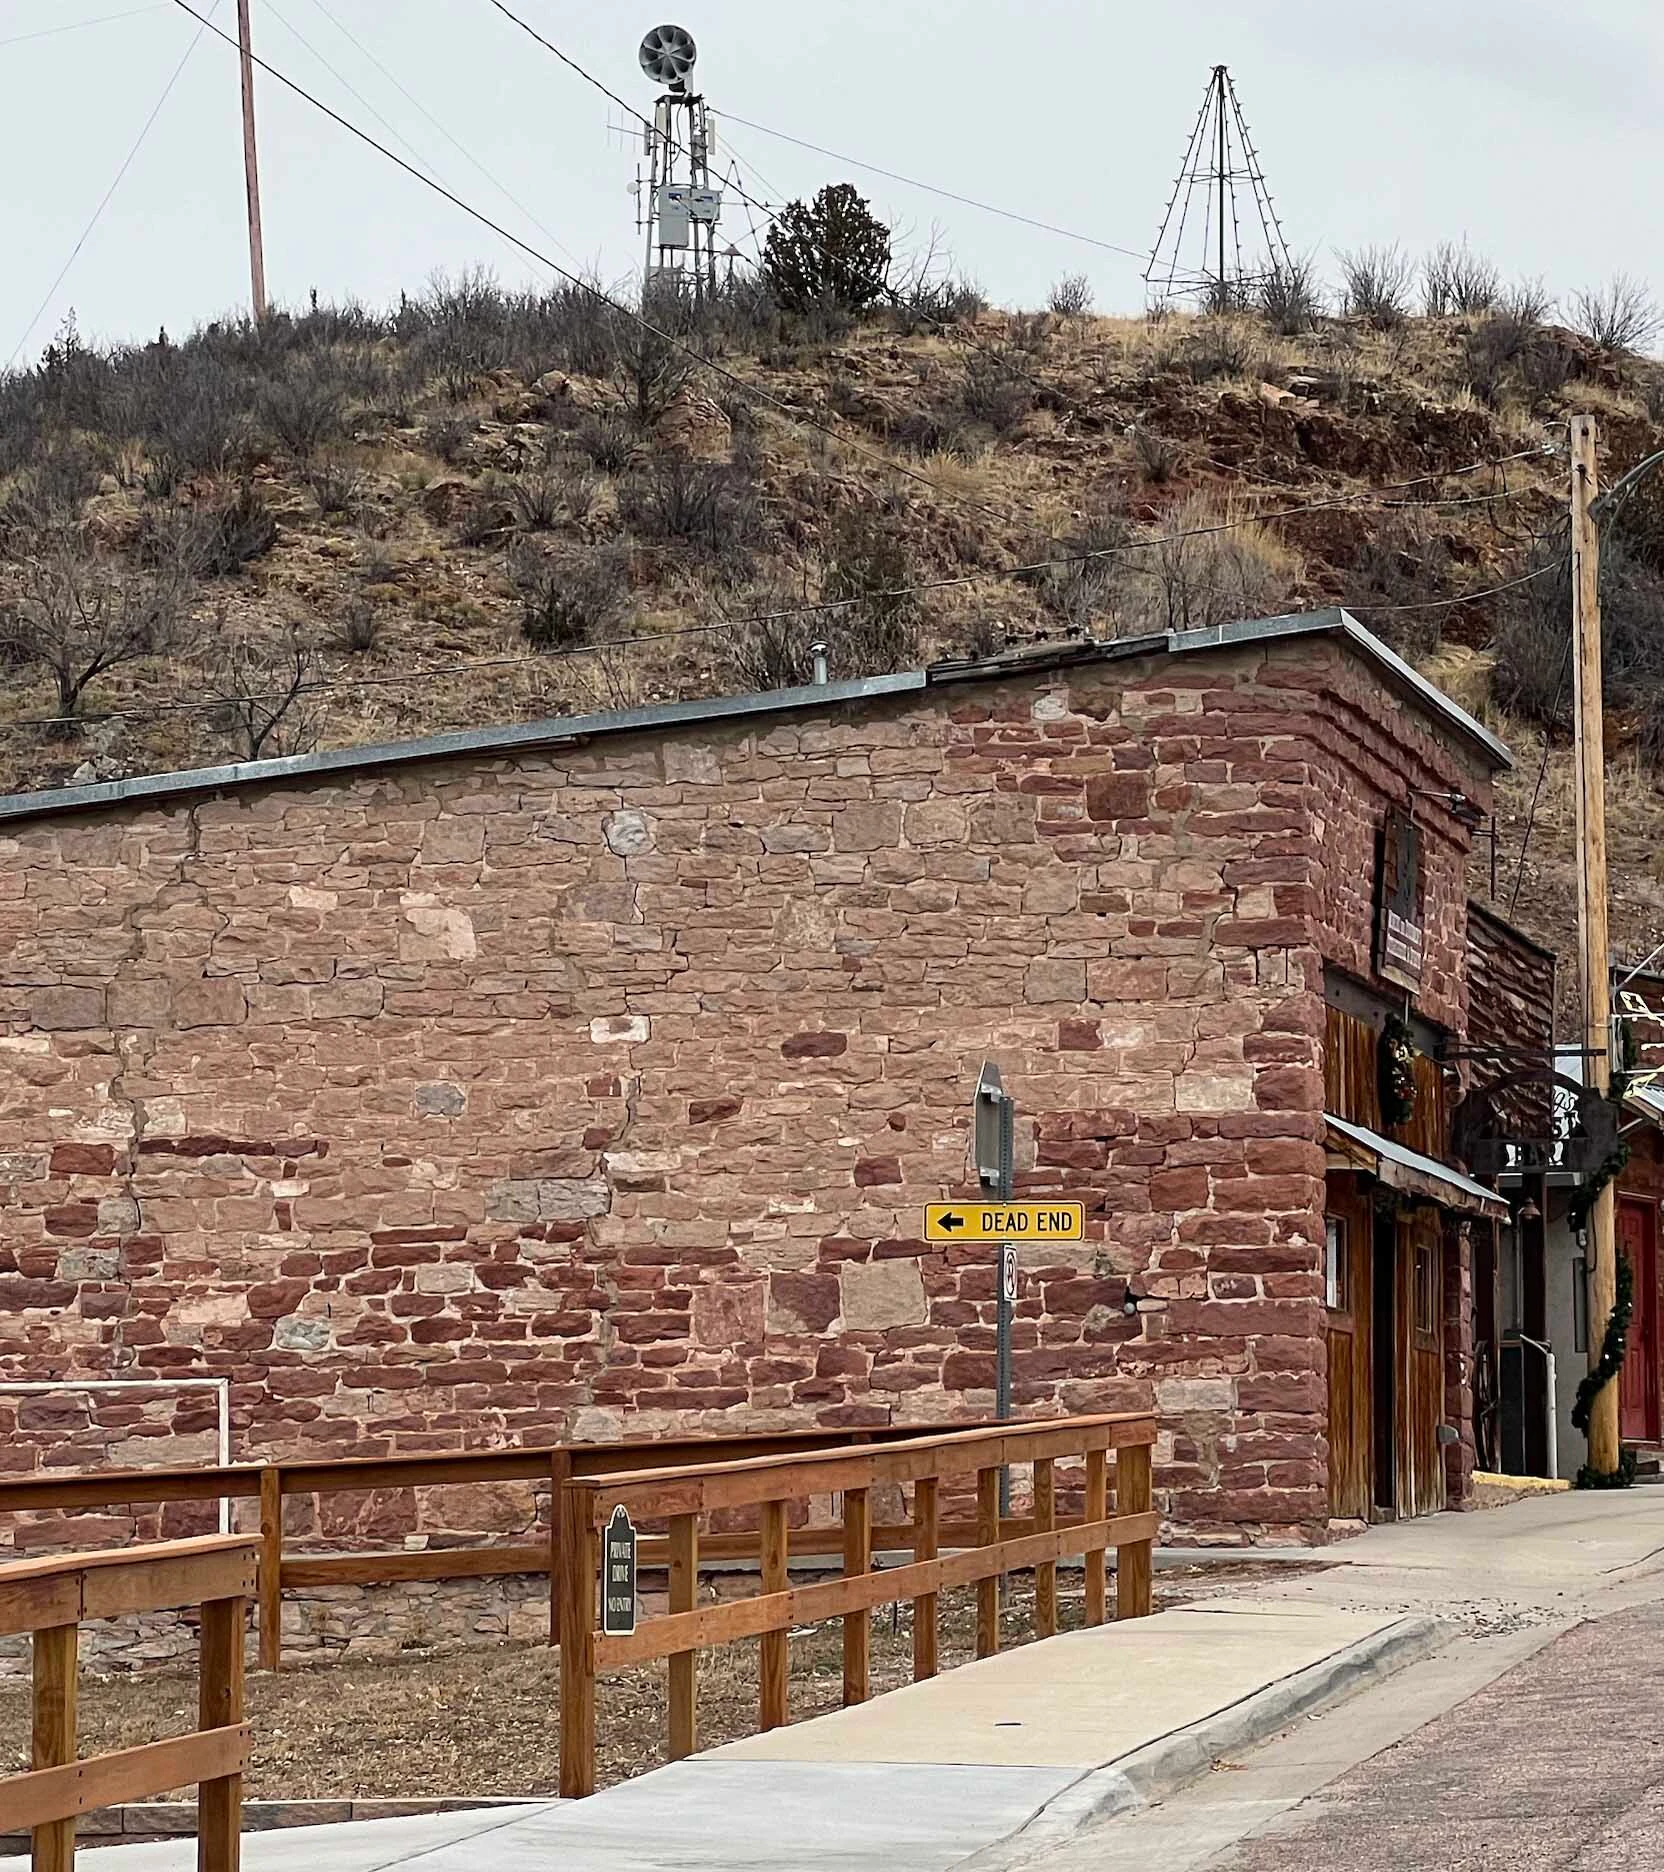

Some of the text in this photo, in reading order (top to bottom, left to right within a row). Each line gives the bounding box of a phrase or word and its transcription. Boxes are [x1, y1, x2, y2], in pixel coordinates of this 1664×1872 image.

[982, 1212, 1072, 1231] DEAD END
[610, 1541, 631, 1559] PRIVATE
[612, 1565, 629, 1582] DRIVE
[608, 1597, 616, 1612] NO
